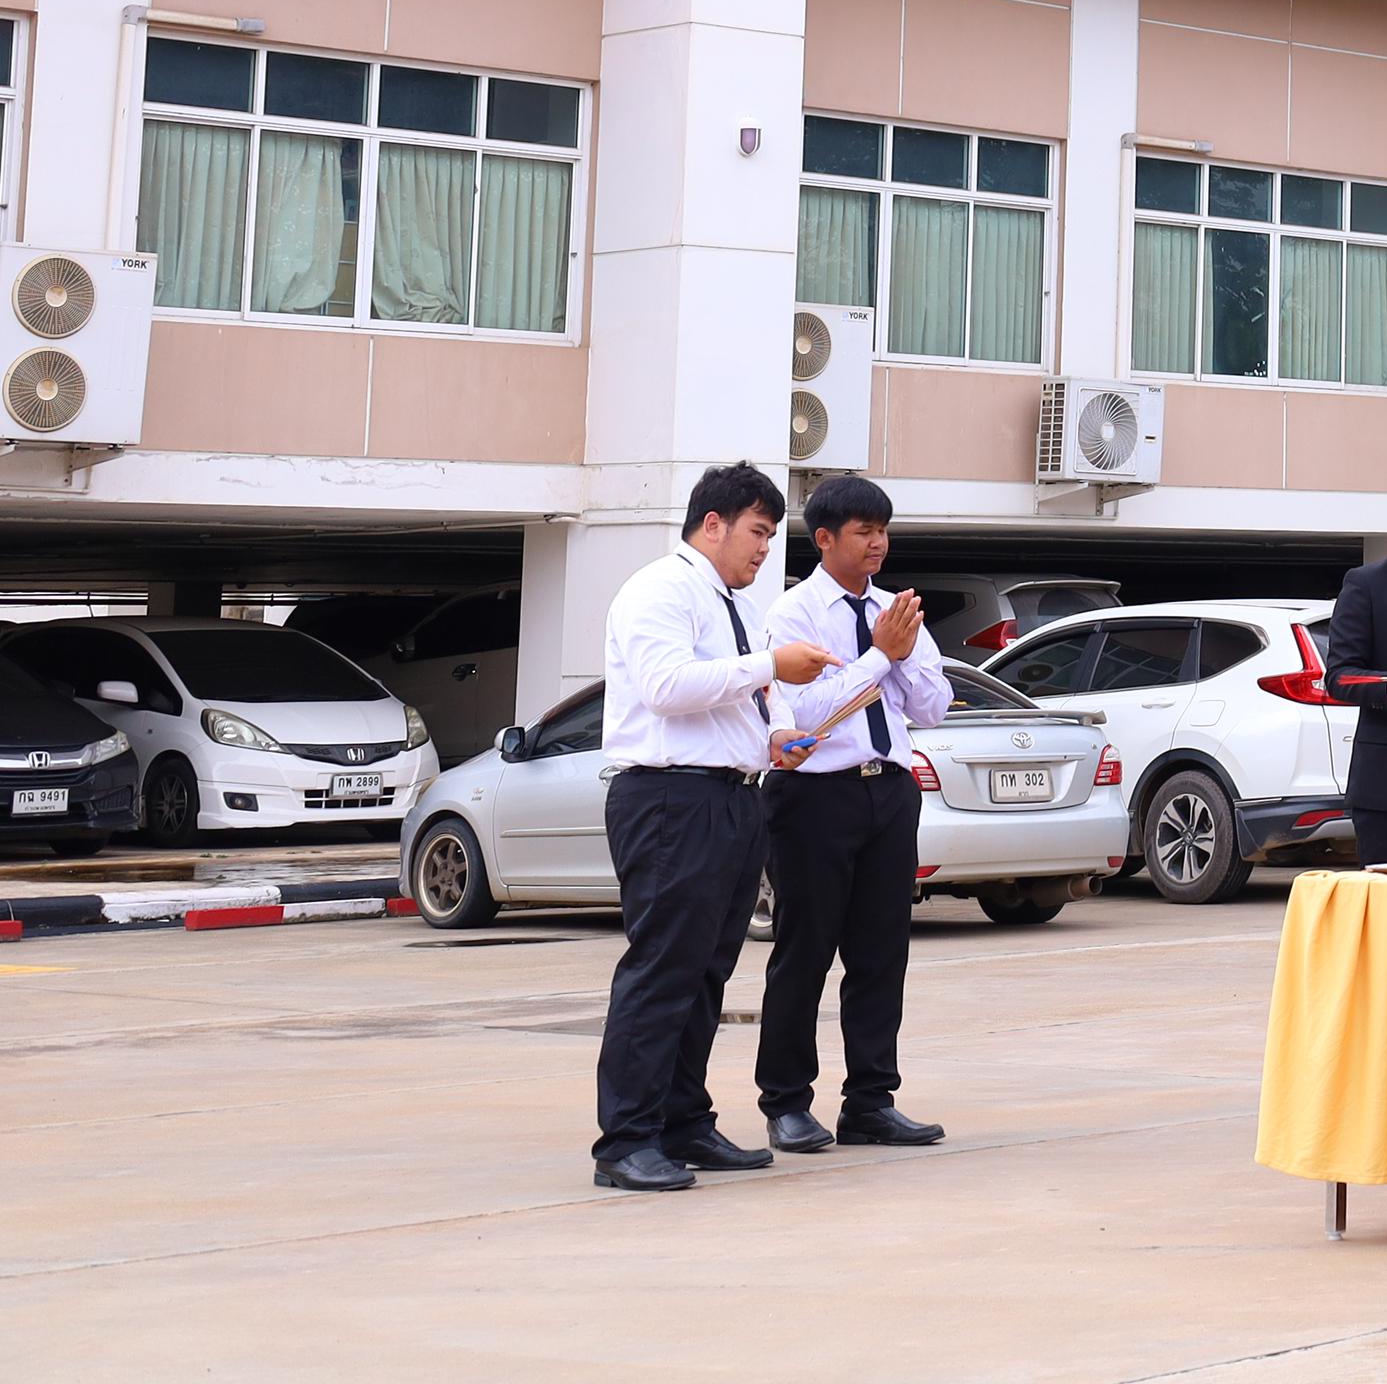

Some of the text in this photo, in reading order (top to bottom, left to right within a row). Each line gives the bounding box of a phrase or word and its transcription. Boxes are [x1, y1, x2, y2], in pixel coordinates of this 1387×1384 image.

[121, 258, 148, 270] YORK
[849, 311, 869, 321] YORK
[356, 776, 380, 786] 2899
[1025, 772, 1045, 786] 302
[40, 790, 66, 802] 9491
